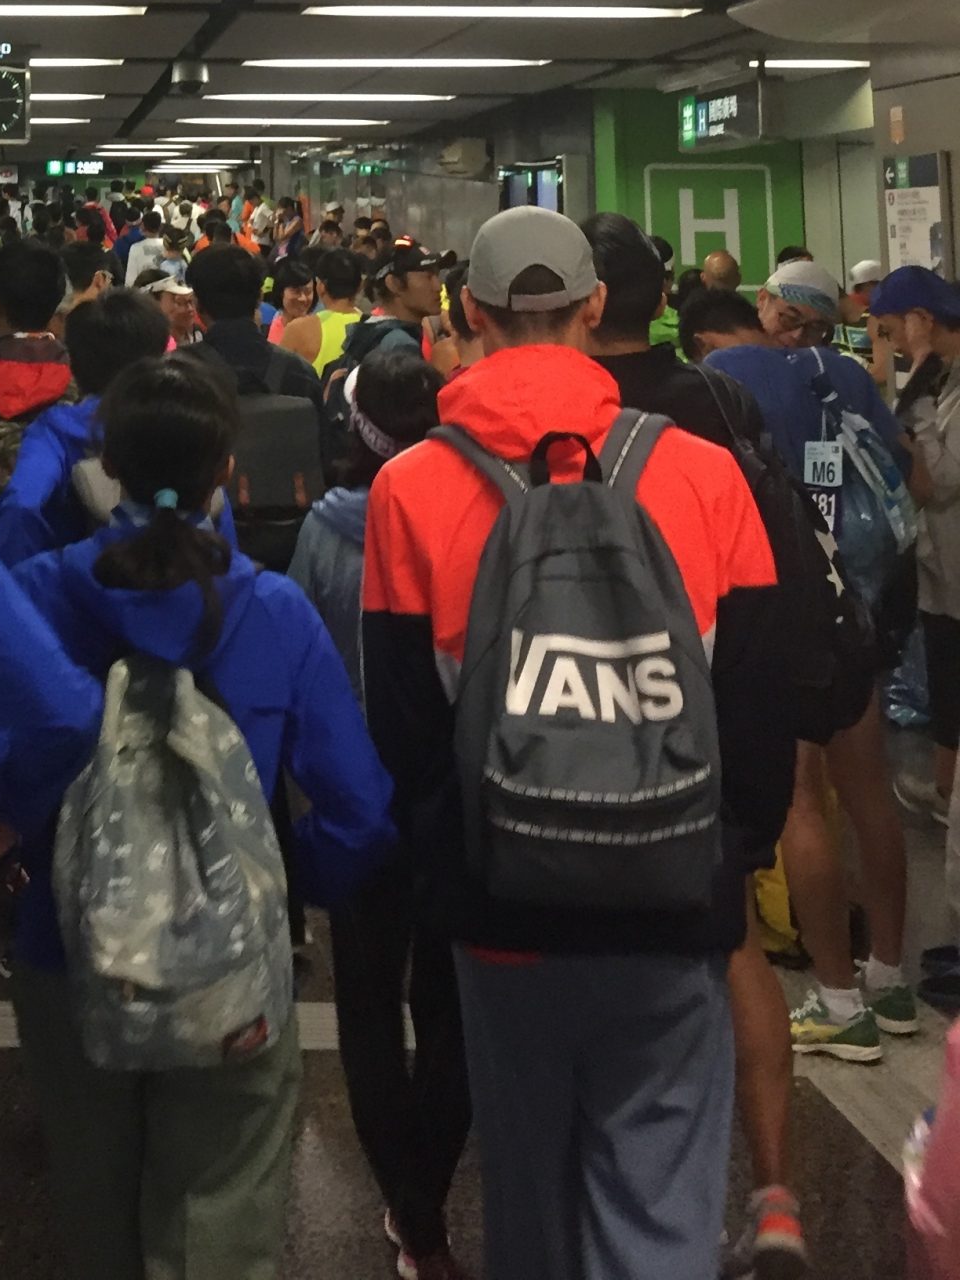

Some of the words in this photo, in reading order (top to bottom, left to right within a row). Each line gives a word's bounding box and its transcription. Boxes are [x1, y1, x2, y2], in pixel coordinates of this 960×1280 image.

[678, 188, 740, 266] H
[812, 461, 835, 483] M6
[505, 627, 684, 725] VANS
